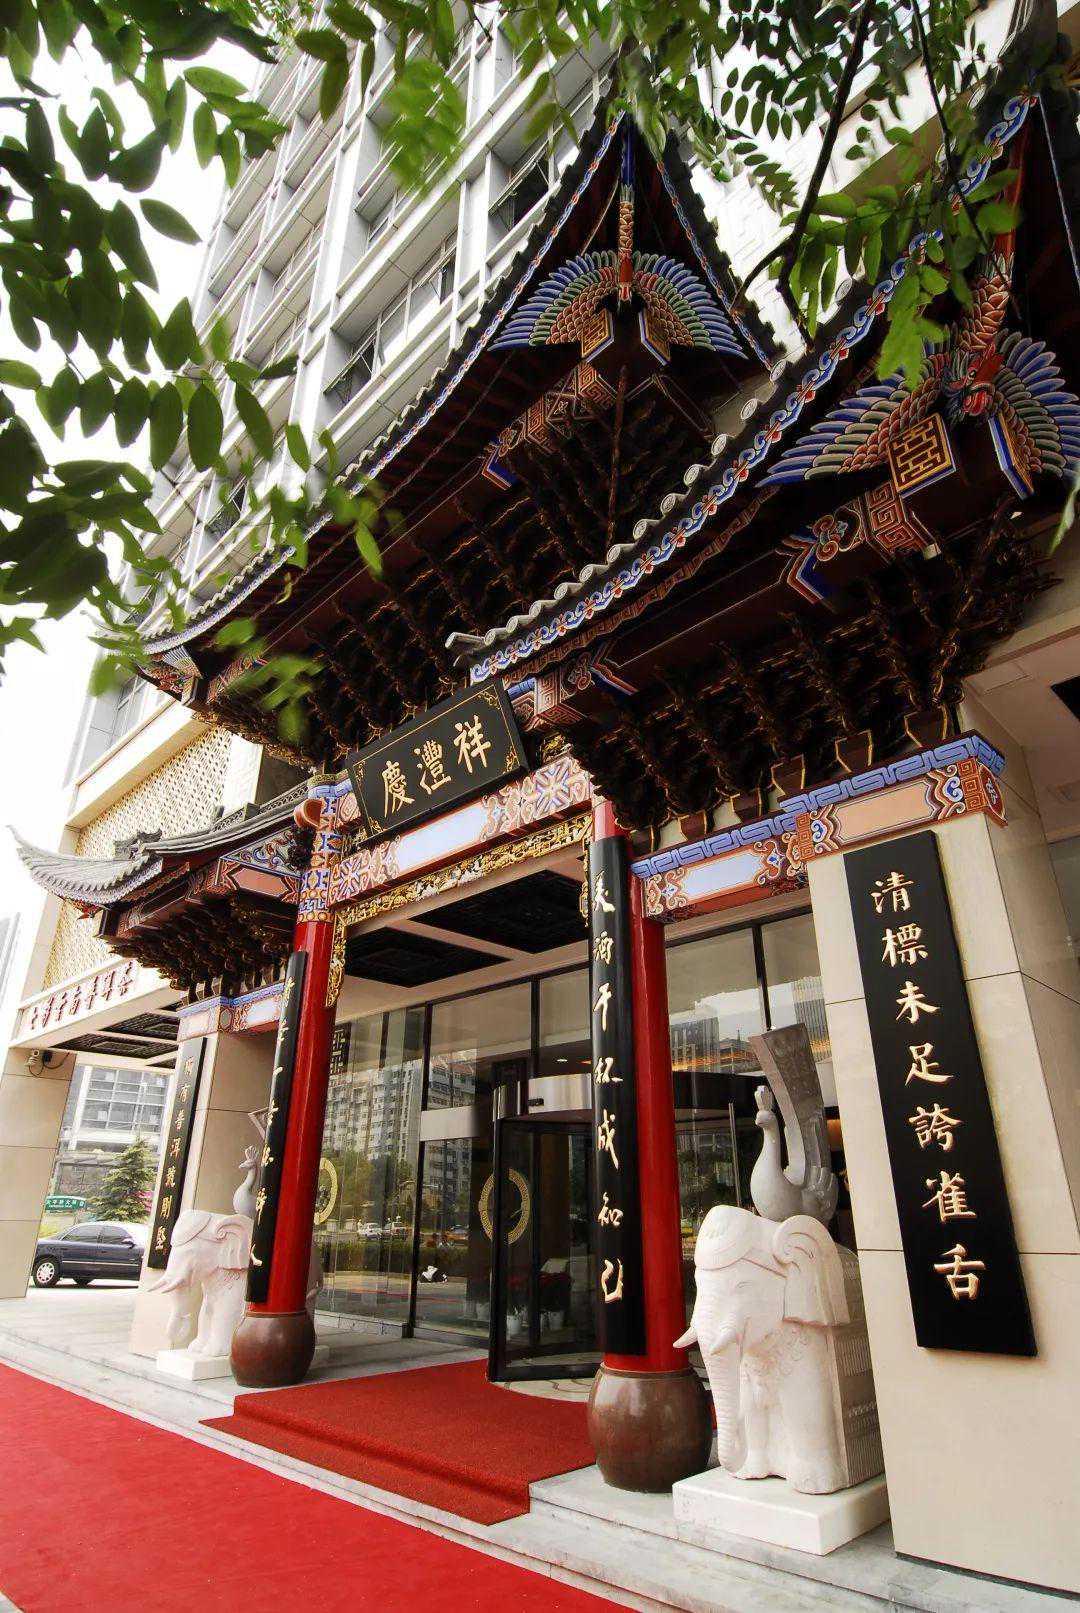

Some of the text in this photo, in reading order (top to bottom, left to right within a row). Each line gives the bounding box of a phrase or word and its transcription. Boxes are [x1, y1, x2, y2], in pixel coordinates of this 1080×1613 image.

[870, 871, 986, 1300] 清標未足誇雀舌
